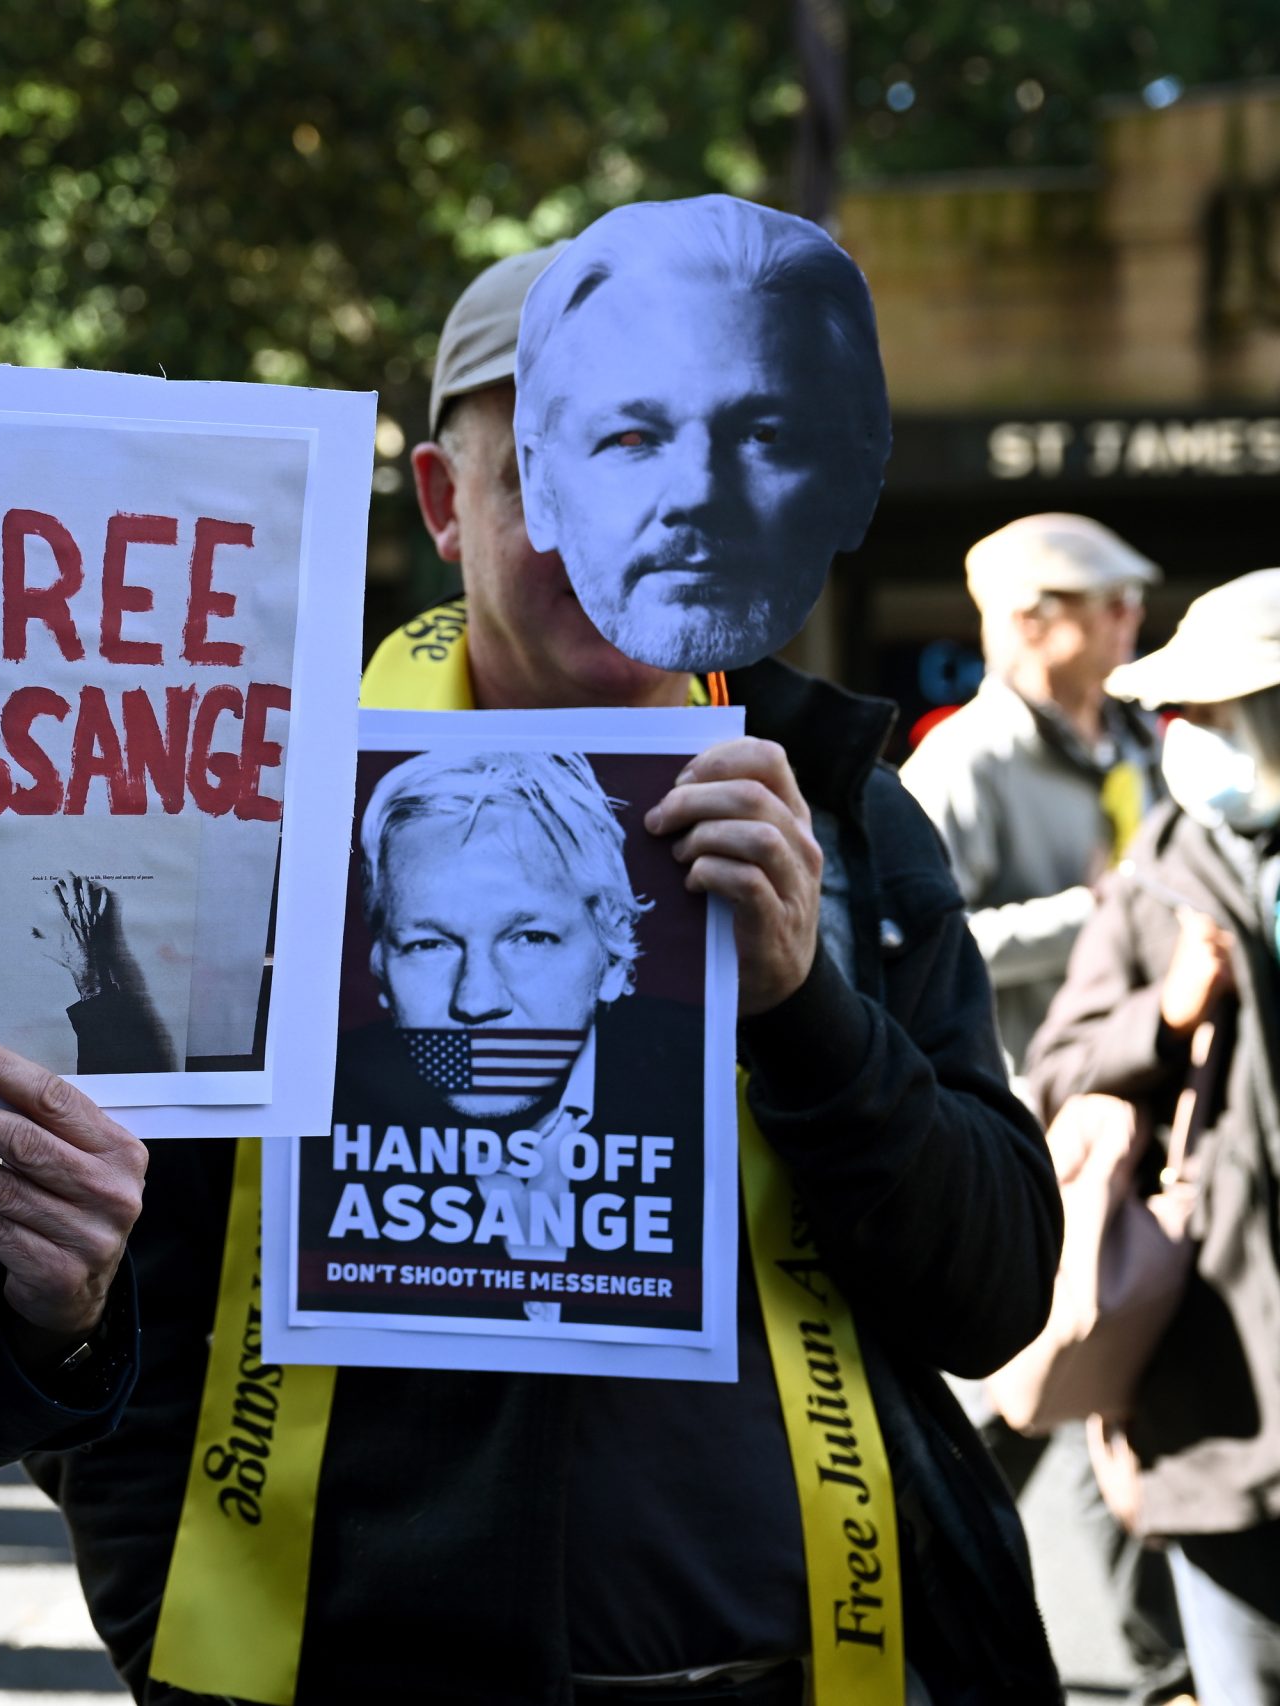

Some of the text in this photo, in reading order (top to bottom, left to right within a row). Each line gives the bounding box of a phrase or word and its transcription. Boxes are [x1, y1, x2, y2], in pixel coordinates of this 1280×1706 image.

[987, 420, 1074, 480] ST
[332, 1123, 675, 1184] HANDS OFF
[328, 1182, 674, 1254] ASSANGE
[400, 1265, 480, 1288] SHOOT
[480, 1269, 525, 1290] THE
[530, 1271, 673, 1298] MESSENGER
[799, 1319, 870, 1506] Julian
[833, 1518, 884, 1656] Free
